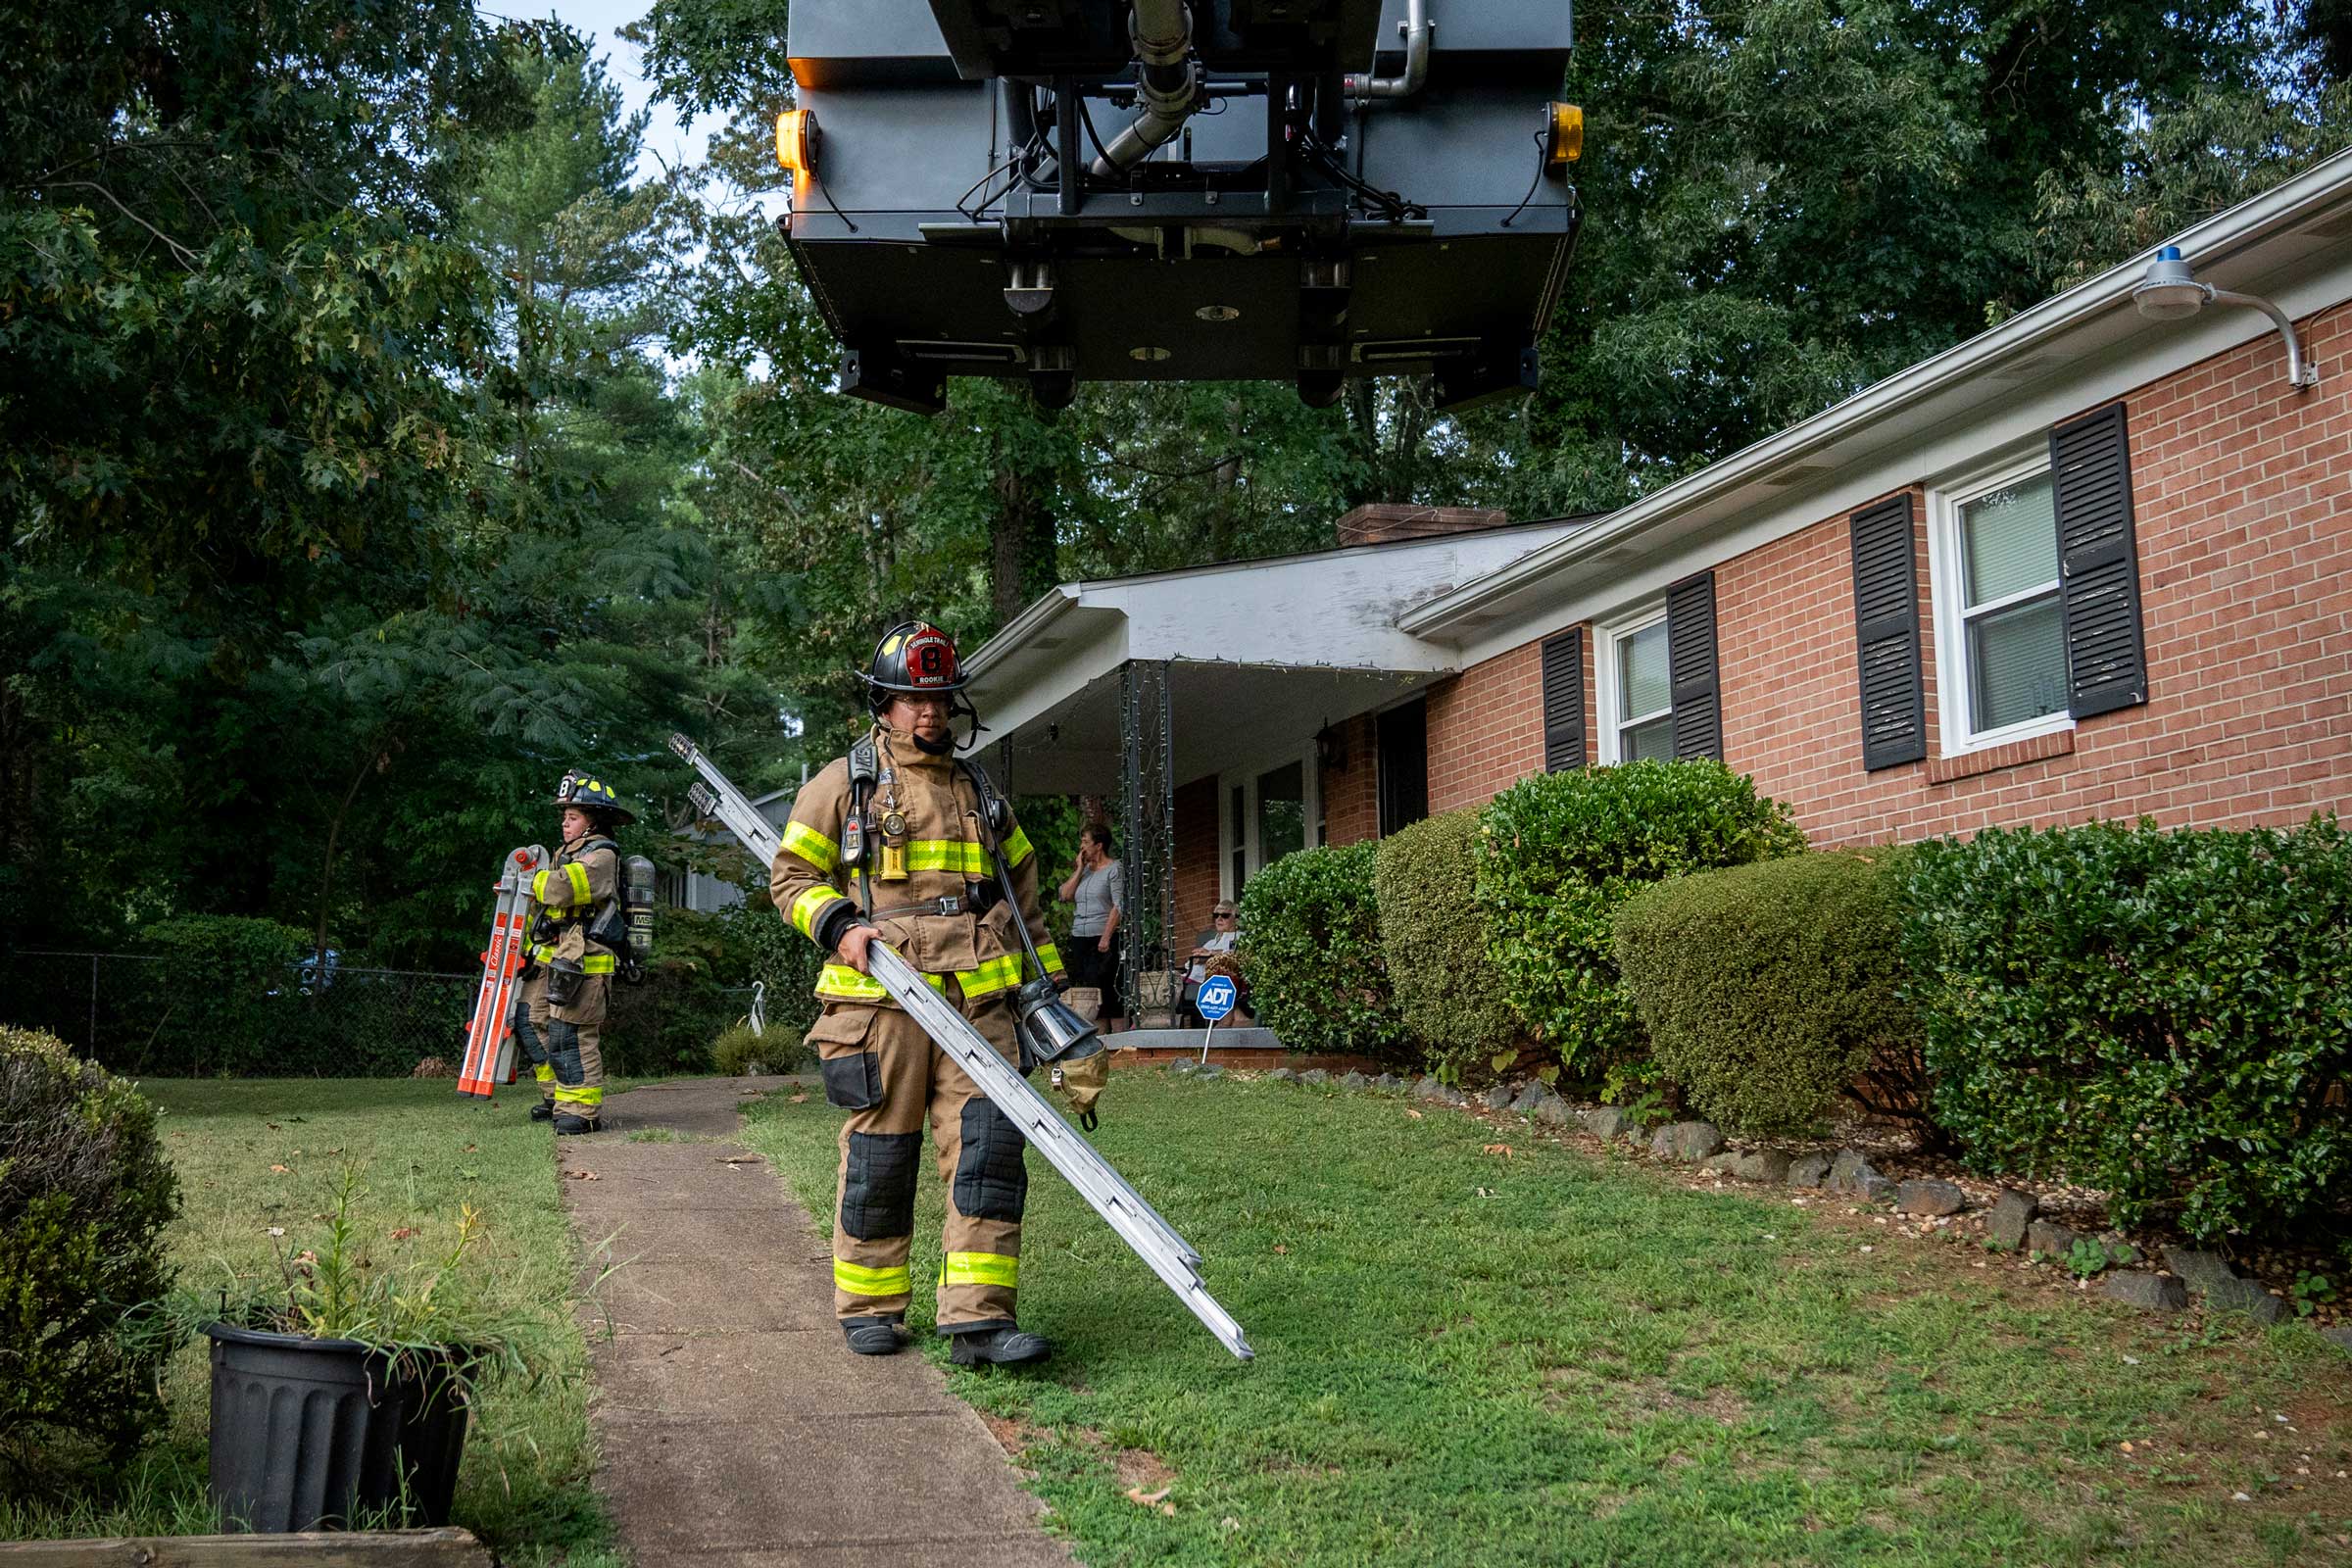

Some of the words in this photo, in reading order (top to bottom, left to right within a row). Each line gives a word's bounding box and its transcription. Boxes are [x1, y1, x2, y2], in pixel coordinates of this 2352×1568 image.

[921, 646, 941, 673] 8
[919, 675, 944, 684] ROOKIE
[560, 780, 569, 797] 8
[490, 935, 503, 966] Classic
[1200, 988, 1233, 1005] ADT
